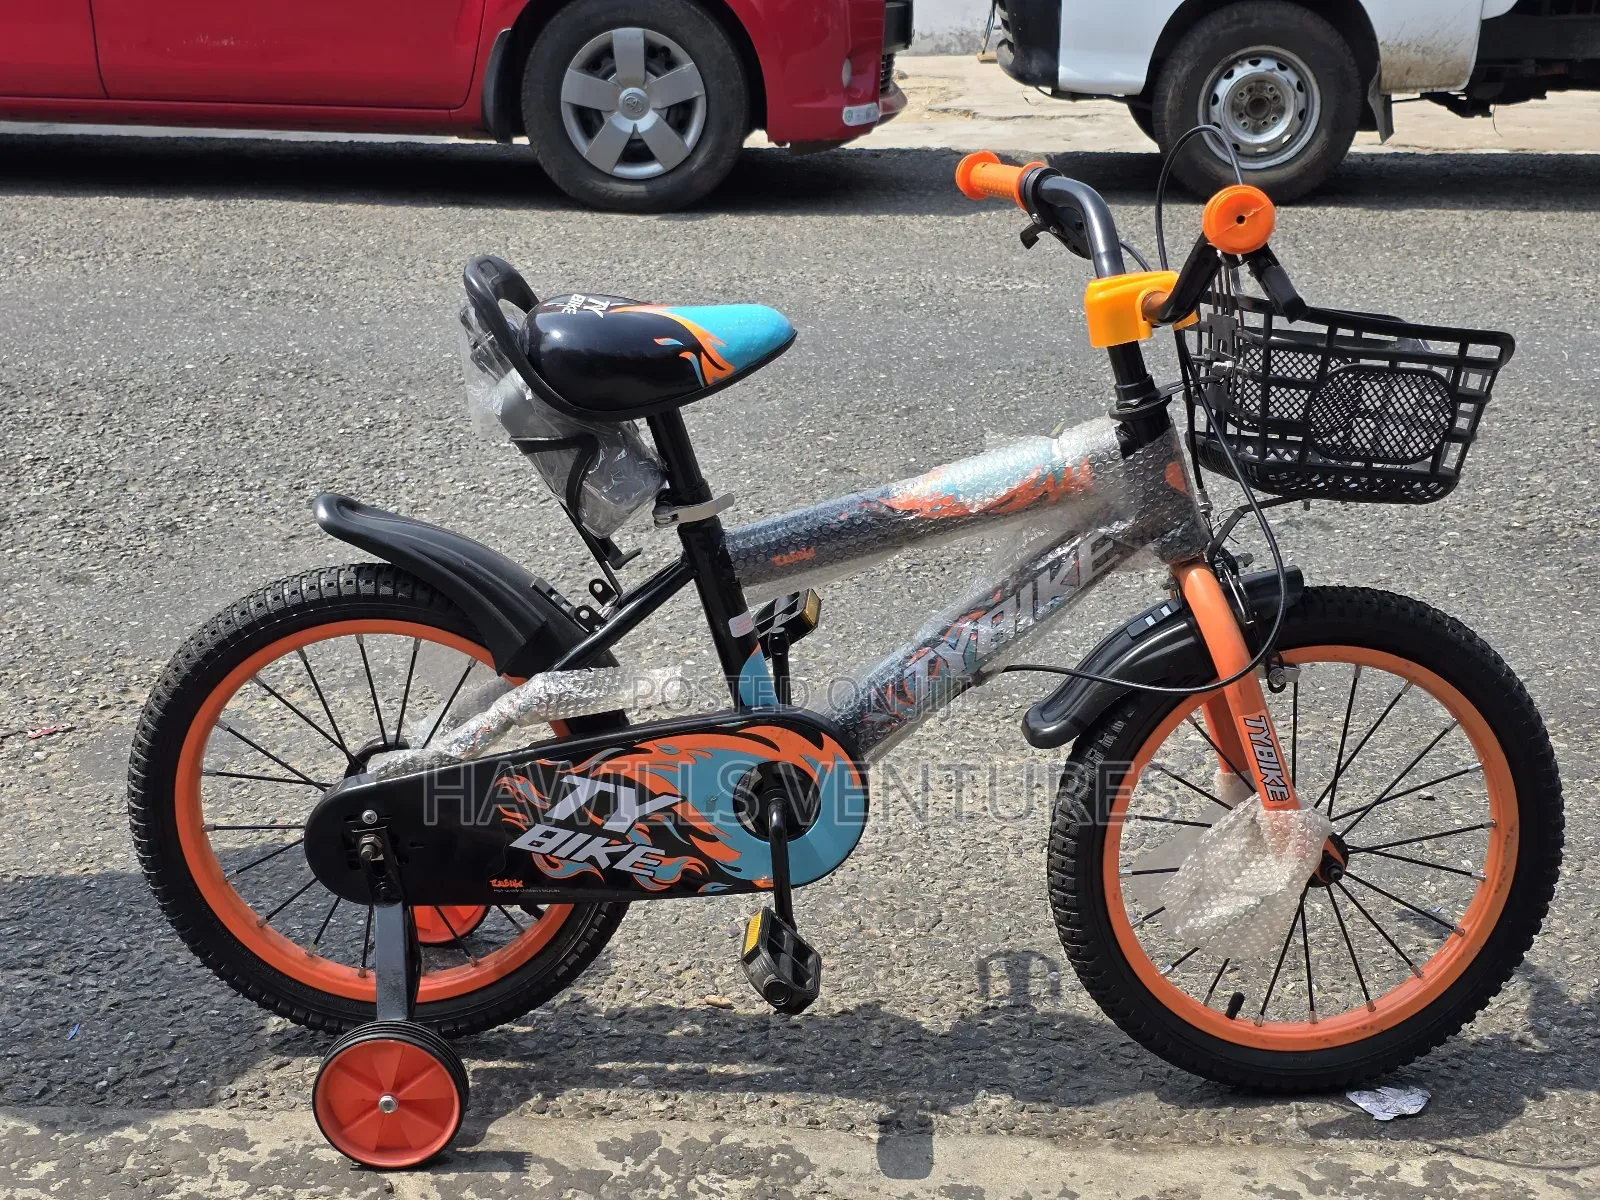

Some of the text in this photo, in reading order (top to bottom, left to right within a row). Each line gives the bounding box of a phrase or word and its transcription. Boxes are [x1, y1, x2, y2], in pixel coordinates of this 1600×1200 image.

[903, 529, 1121, 702] TYBIKE
[1242, 714, 1291, 803] TYBIKE
[543, 774, 687, 834] TY
[509, 823, 669, 878] BIKE
